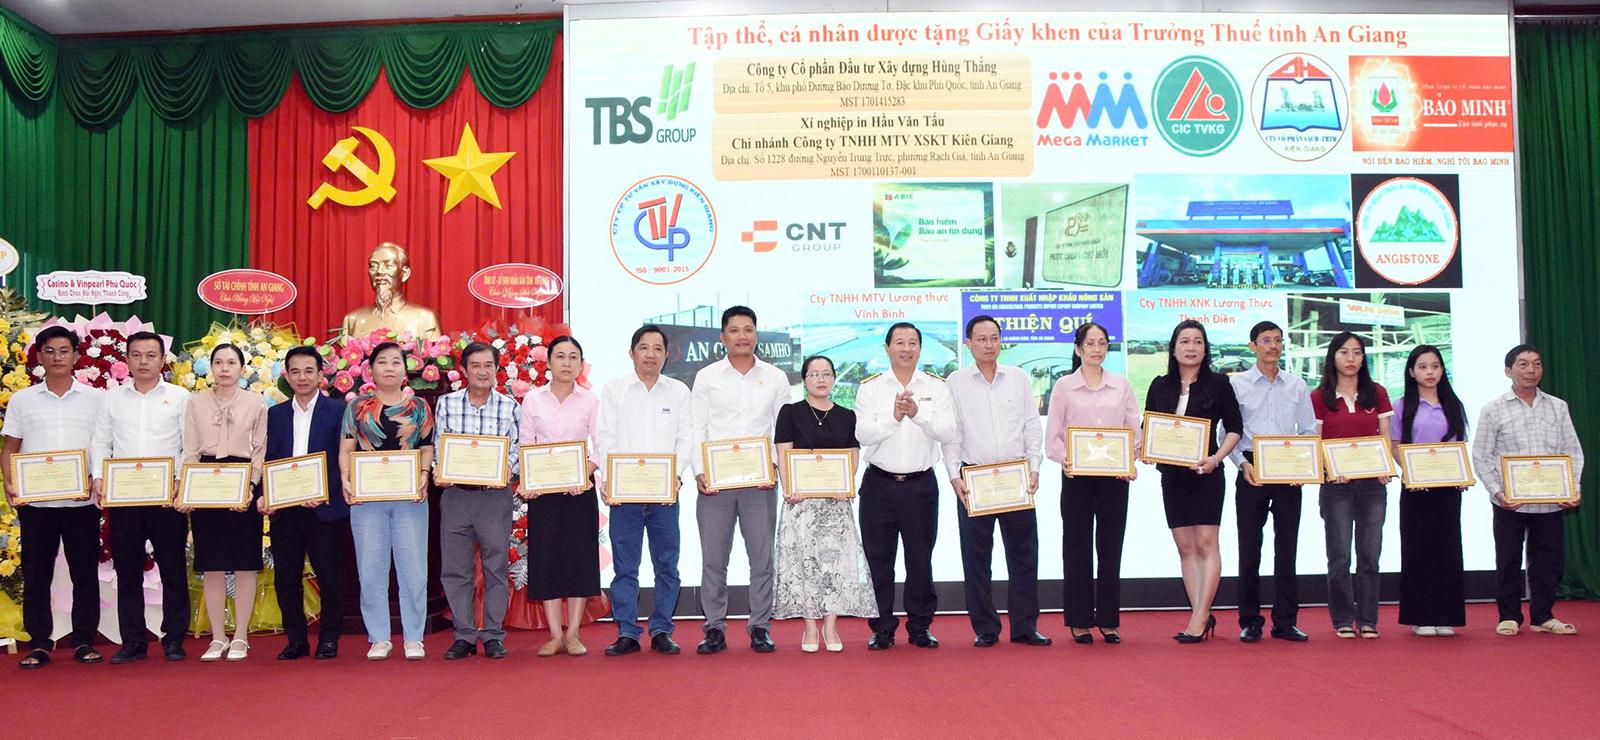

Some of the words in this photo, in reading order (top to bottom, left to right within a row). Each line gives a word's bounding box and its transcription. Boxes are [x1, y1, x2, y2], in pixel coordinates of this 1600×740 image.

[687, 27, 728, 50] Tập
[736, 20, 773, 46] thể,
[779, 25, 800, 43] cá
[808, 24, 859, 43] nhân
[925, 24, 970, 46] tặng
[976, 18, 1024, 46] Giấy
[1032, 22, 1080, 41] khen
[1088, 22, 1122, 42] của
[1129, 22, 1205, 46] Trưởng
[1210, 18, 1261, 42] Thuế
[1268, 22, 1308, 42] tỉnh
[1313, 25, 1342, 43] An
[1347, 24, 1408, 47] Giang
[747, 62, 775, 78] Công
[778, 64, 788, 78] ty
[791, 58, 806, 76] Cổ
[809, 58, 835, 77] phần
[839, 57, 860, 75] Đầu
[863, 61, 876, 75] tư
[878, 60, 897, 77] Xây
[902, 61, 928, 76] dựng
[932, 60, 960, 77] Hùng
[964, 56, 997, 76] Thắng
[776, 81, 791, 93] khu
[913, 79, 928, 91] khu
[986, 79, 997, 90] An
[1000, 79, 1022, 92] Giang
[840, 97, 857, 107] MST
[861, 96, 905, 107] 1701415283
[1423, 92, 1457, 116] BẢO
[1461, 99, 1507, 116] MINH
[585, 96, 653, 145] TBS
[801, 117, 813, 129] Xí
[817, 116, 853, 131] nghiệp
[857, 117, 867, 128] in
[898, 115, 919, 127] Văn
[656, 128, 696, 143] GROUP
[1171, 123, 1191, 135] CIC
[1193, 123, 1226, 135] TVKG
[731, 137, 751, 149] Chi
[755, 137, 789, 149] nhánh
[793, 136, 822, 150] Công
[825, 138, 836, 150] ty
[840, 135, 876, 147] TNHH
[881, 135, 910, 146] MTV
[914, 135, 948, 146] XSKT
[952, 134, 977, 146] Kiên
[981, 134, 1014, 148] Giang
[767, 154, 786, 164] 1228
[849, 153, 872, 164] Trung
[988, 152, 1000, 162] An
[1001, 151, 1025, 163] Giang
[1490, 157, 1509, 166] MINH
[830, 167, 849, 177] MST
[786, 222, 847, 240] CNT
[792, 243, 841, 252] GROUP
[1376, 254, 1440, 264] ANGISTONE
[653, 265, 689, 273] 9001-2015
[47, 280, 68, 288] Casino
[70, 280, 75, 288] &
[77, 280, 104, 289] Vinpearl
[260, 282, 268, 291] AN
[268, 282, 285, 293] GIANG
[810, 294, 827, 305] Cty
[830, 293, 859, 303] TNHH
[862, 293, 886, 303] MTV
[889, 293, 922, 304] Lương
[925, 292, 949, 303] thực
[970, 294, 989, 302] CÔNG
[990, 294, 998, 302] TY
[1001, 294, 1018, 302] TNHH
[1139, 298, 1155, 310] Cty
[1158, 298, 1187, 307] TNHH
[1190, 298, 1211, 308] XNK
[1214, 298, 1245, 310] Lương
[685, 341, 712, 362] AN
[758, 342, 791, 358] SAMHO
